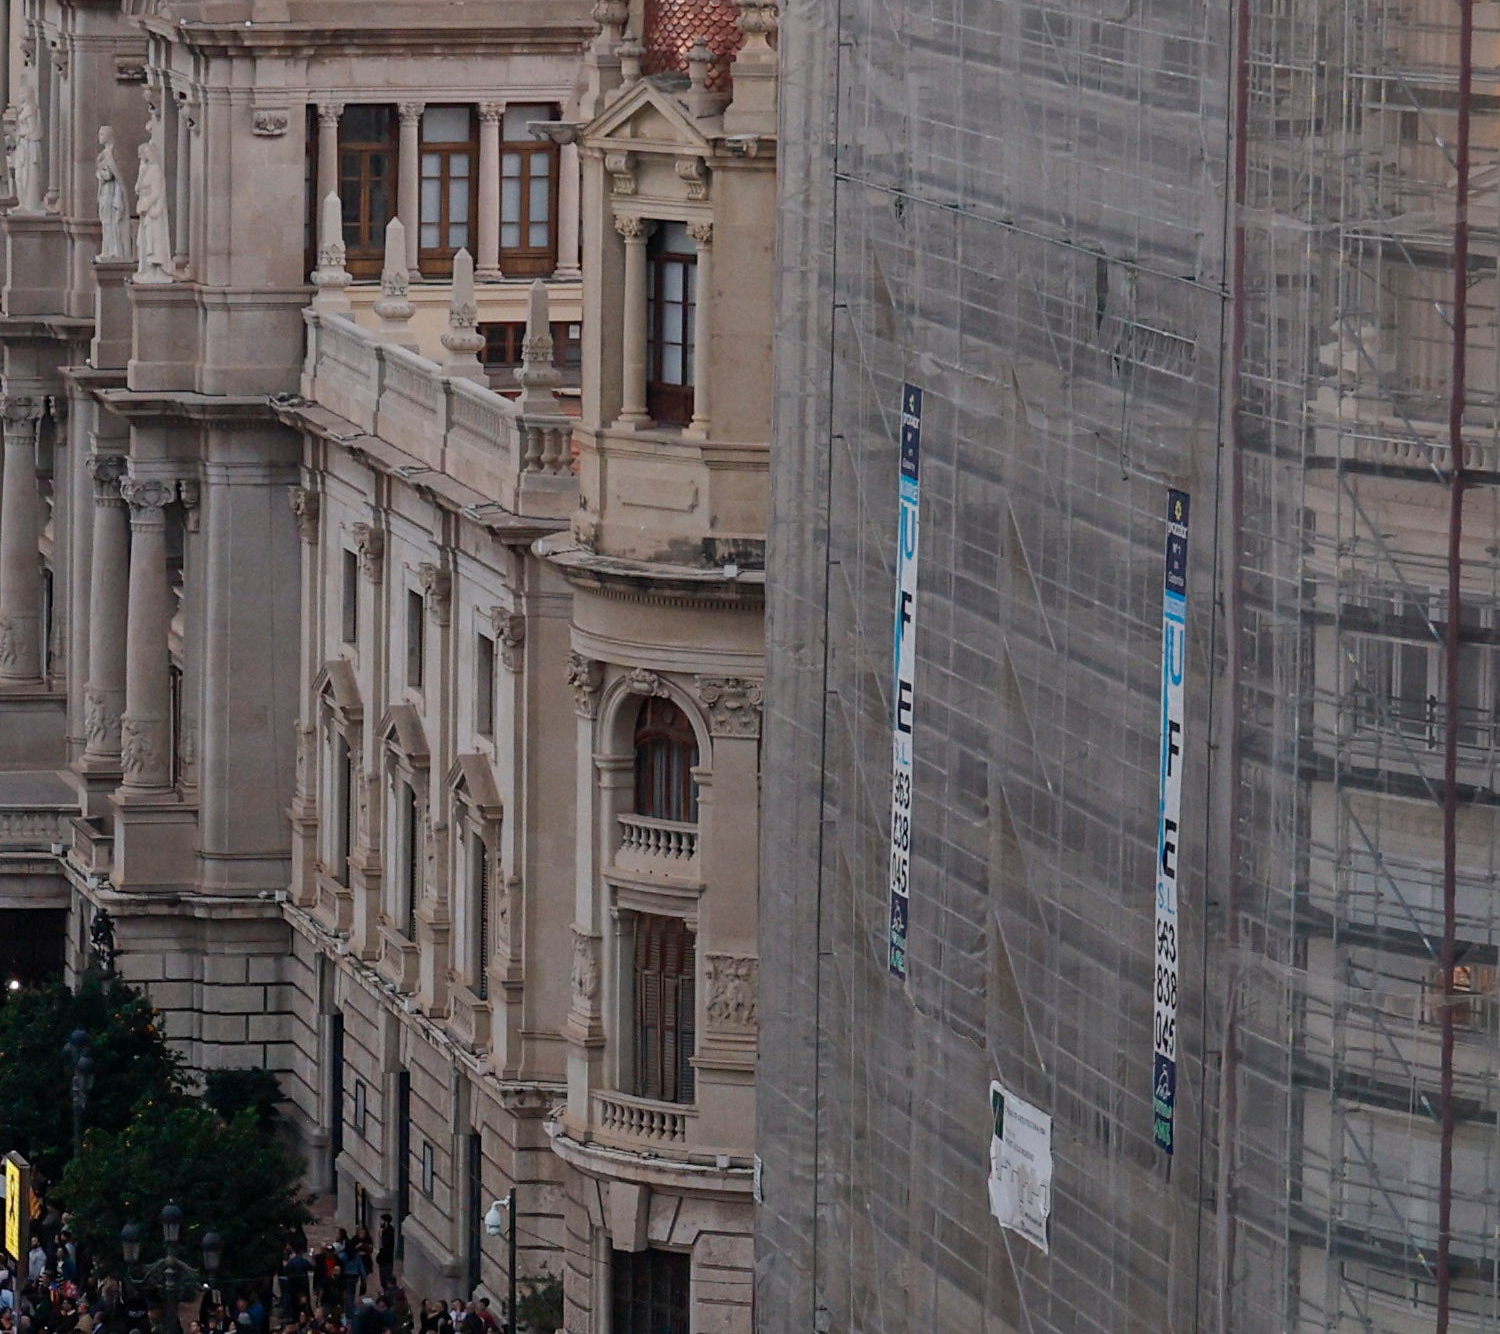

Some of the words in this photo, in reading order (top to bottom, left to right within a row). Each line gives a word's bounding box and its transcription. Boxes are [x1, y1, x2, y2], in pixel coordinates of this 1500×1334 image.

[900, 590, 913, 642] F
[898, 678, 912, 734] E
[1167, 720, 1181, 777] F
[1163, 818, 1177, 880] E
[1157, 918, 1176, 964] 963
[1156, 964, 1176, 1010] 838
[1155, 1011, 1176, 1055] 045
